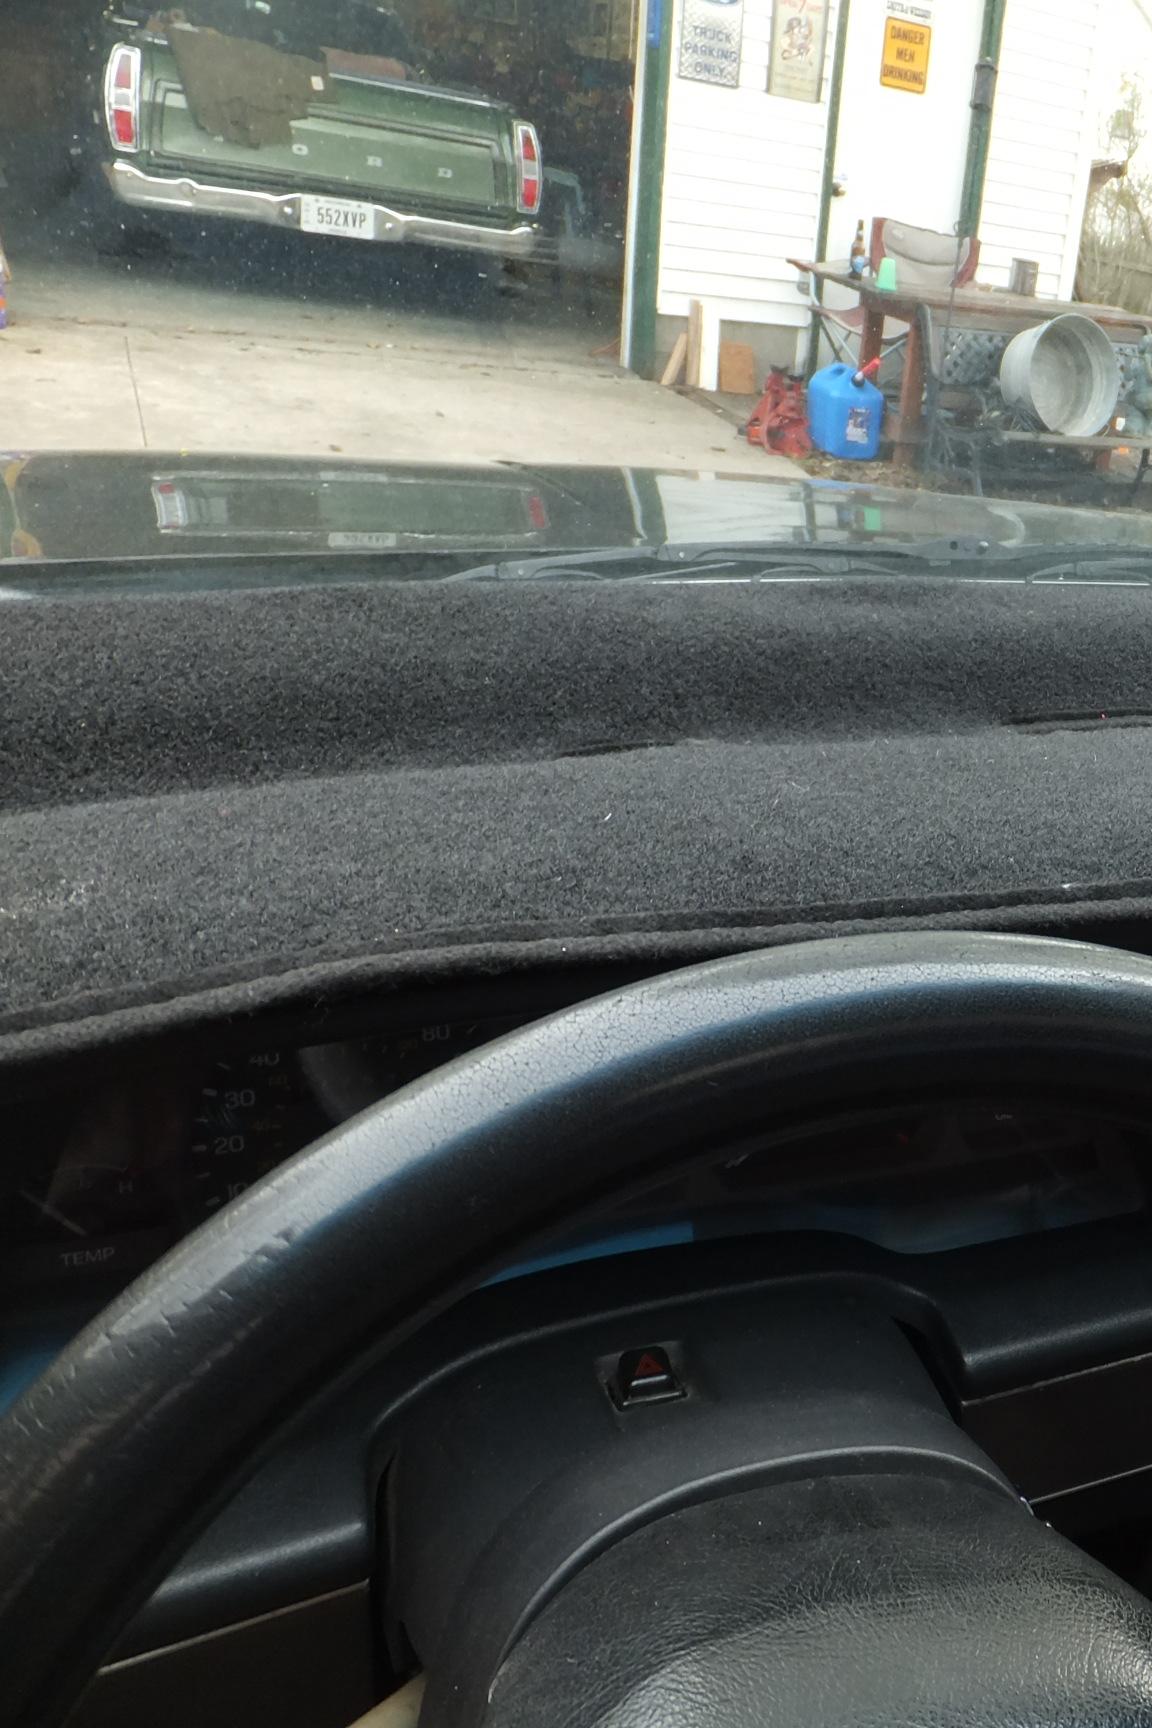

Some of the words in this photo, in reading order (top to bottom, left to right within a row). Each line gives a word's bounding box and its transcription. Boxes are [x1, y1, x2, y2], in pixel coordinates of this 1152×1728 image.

[692, 25, 732, 43] TRUCK
[890, 25, 925, 45] DANGER
[684, 41, 738, 63] PARKING
[895, 47, 915, 63] MEN
[694, 61, 726, 78] ONLY
[882, 64, 925, 86] DRINKING
[316, 206, 367, 229] 552XVP
[224, 1088, 256, 1109] 30
[213, 1134, 245, 1155] 20
[118, 1179, 134, 1194] H
[60, 1246, 116, 1267] TEMP
